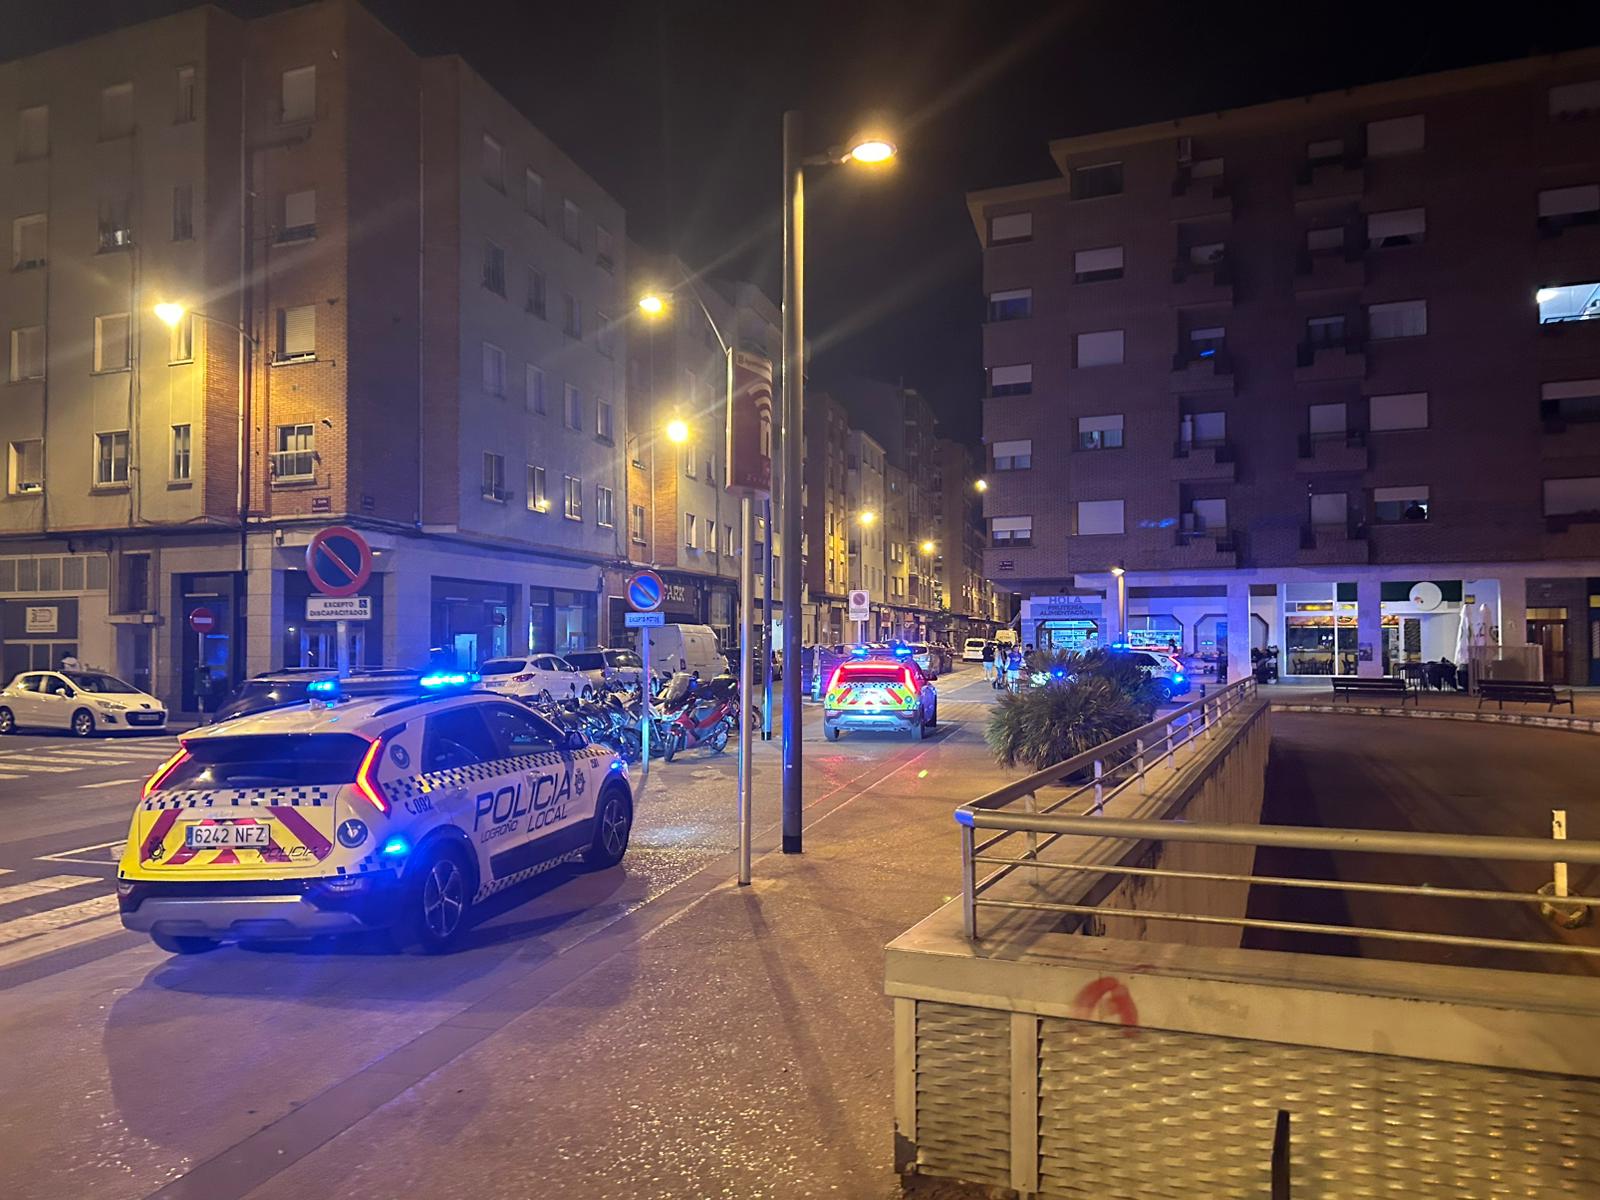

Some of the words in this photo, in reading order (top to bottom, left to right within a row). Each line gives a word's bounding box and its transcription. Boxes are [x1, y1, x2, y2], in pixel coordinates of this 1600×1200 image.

[1049, 596, 1082, 604] HOLA
[414, 796, 433, 813] 092
[473, 770, 571, 832] POLICIA
[481, 819, 519, 843] LOGROÑO
[527, 804, 568, 833] LOCAL
[195, 827, 229, 843] 6242
[236, 827, 265, 843] NFZ
